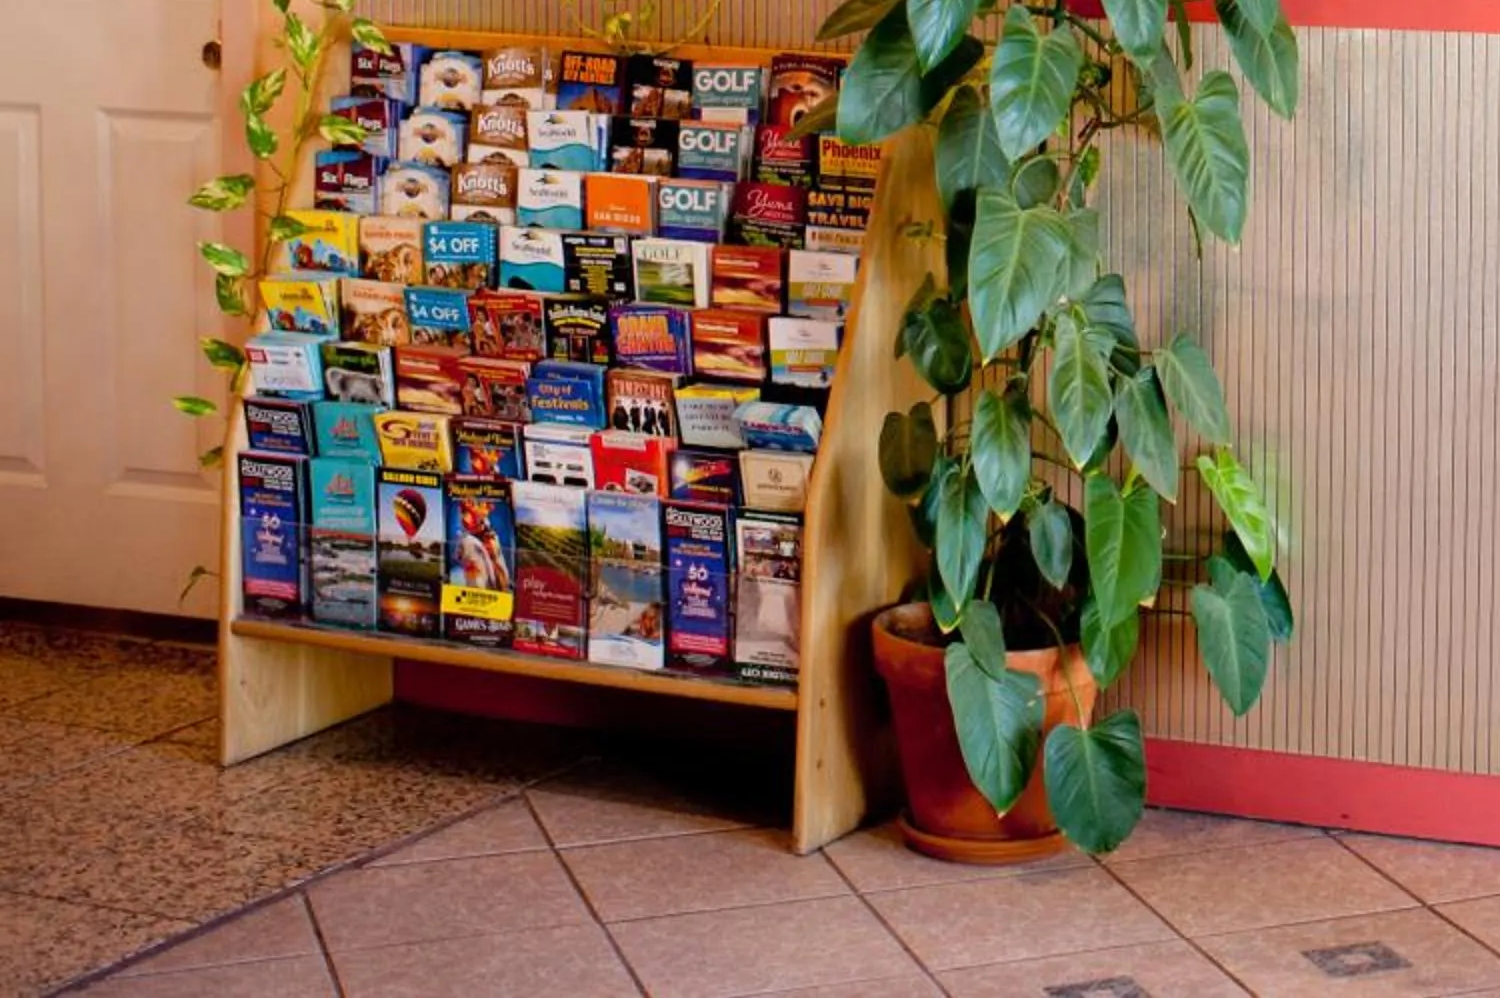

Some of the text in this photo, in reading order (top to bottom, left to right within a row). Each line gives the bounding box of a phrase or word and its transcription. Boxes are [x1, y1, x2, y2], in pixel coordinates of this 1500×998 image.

[695, 70, 756, 92] GOLF
[679, 129, 738, 154] GOLF
[822, 140, 881, 162] Phoenix
[659, 187, 717, 212] GOLF
[807, 191, 845, 207] SAVE
[428, 237, 481, 254] $4 OFF
[431, 306, 461, 322] OFF
[531, 396, 590, 411] Festivals
